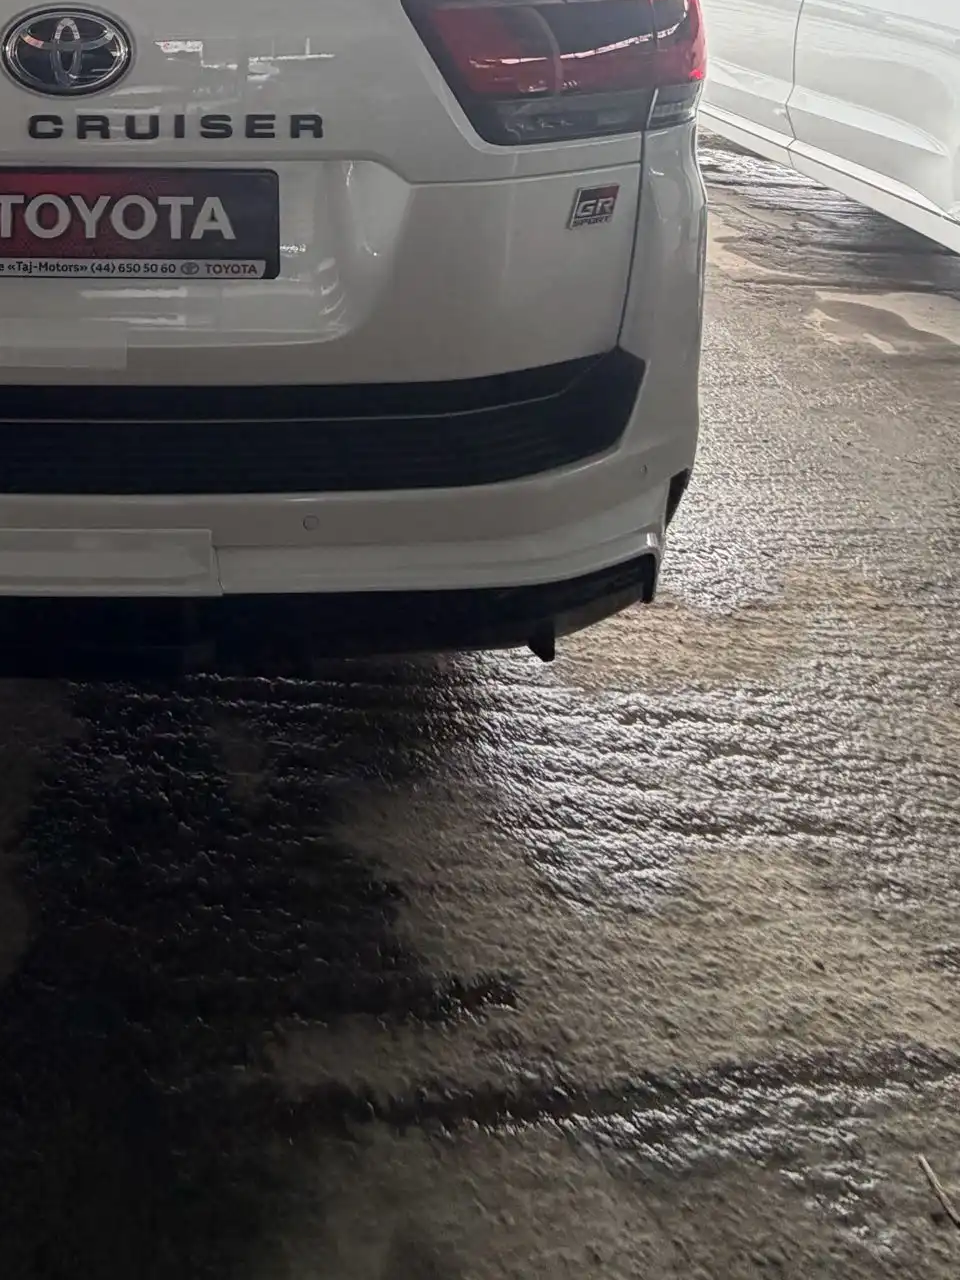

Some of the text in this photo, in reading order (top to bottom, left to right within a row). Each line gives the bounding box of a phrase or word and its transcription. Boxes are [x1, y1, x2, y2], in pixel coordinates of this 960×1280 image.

[27, 113, 324, 140] CRUISER
[7, 261, 88, 274] «Taj-Motors»
[91, 262, 115, 274] (44)
[118, 263, 141, 273] 650
[143, 263, 159, 273] 50
[160, 263, 176, 273] 60
[204, 263, 258, 275] TOYOTA
